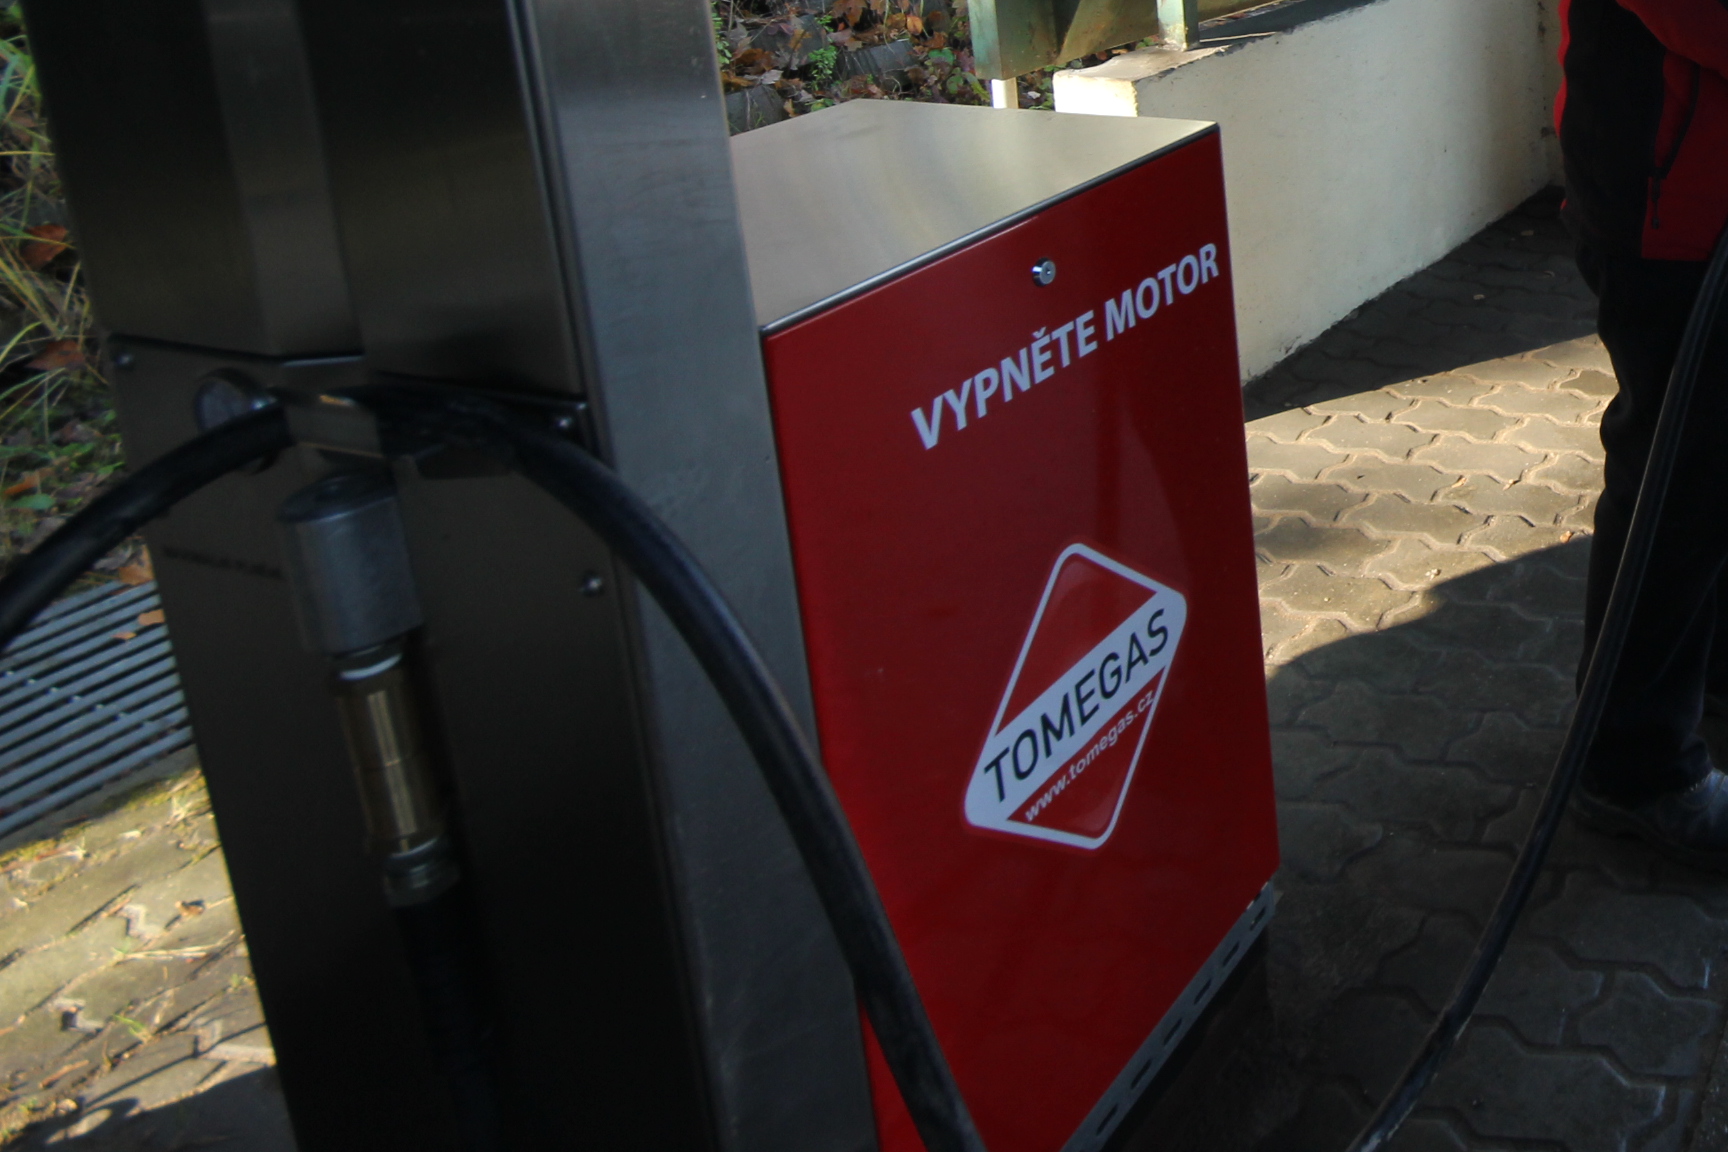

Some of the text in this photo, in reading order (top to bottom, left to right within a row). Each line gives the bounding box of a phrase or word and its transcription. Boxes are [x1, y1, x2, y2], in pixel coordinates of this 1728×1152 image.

[911, 241, 1220, 451] VYPNĚTE MOTOR
[983, 608, 1170, 802] TOMEGAS
[1024, 689, 1157, 823] www.tomegas.cz
